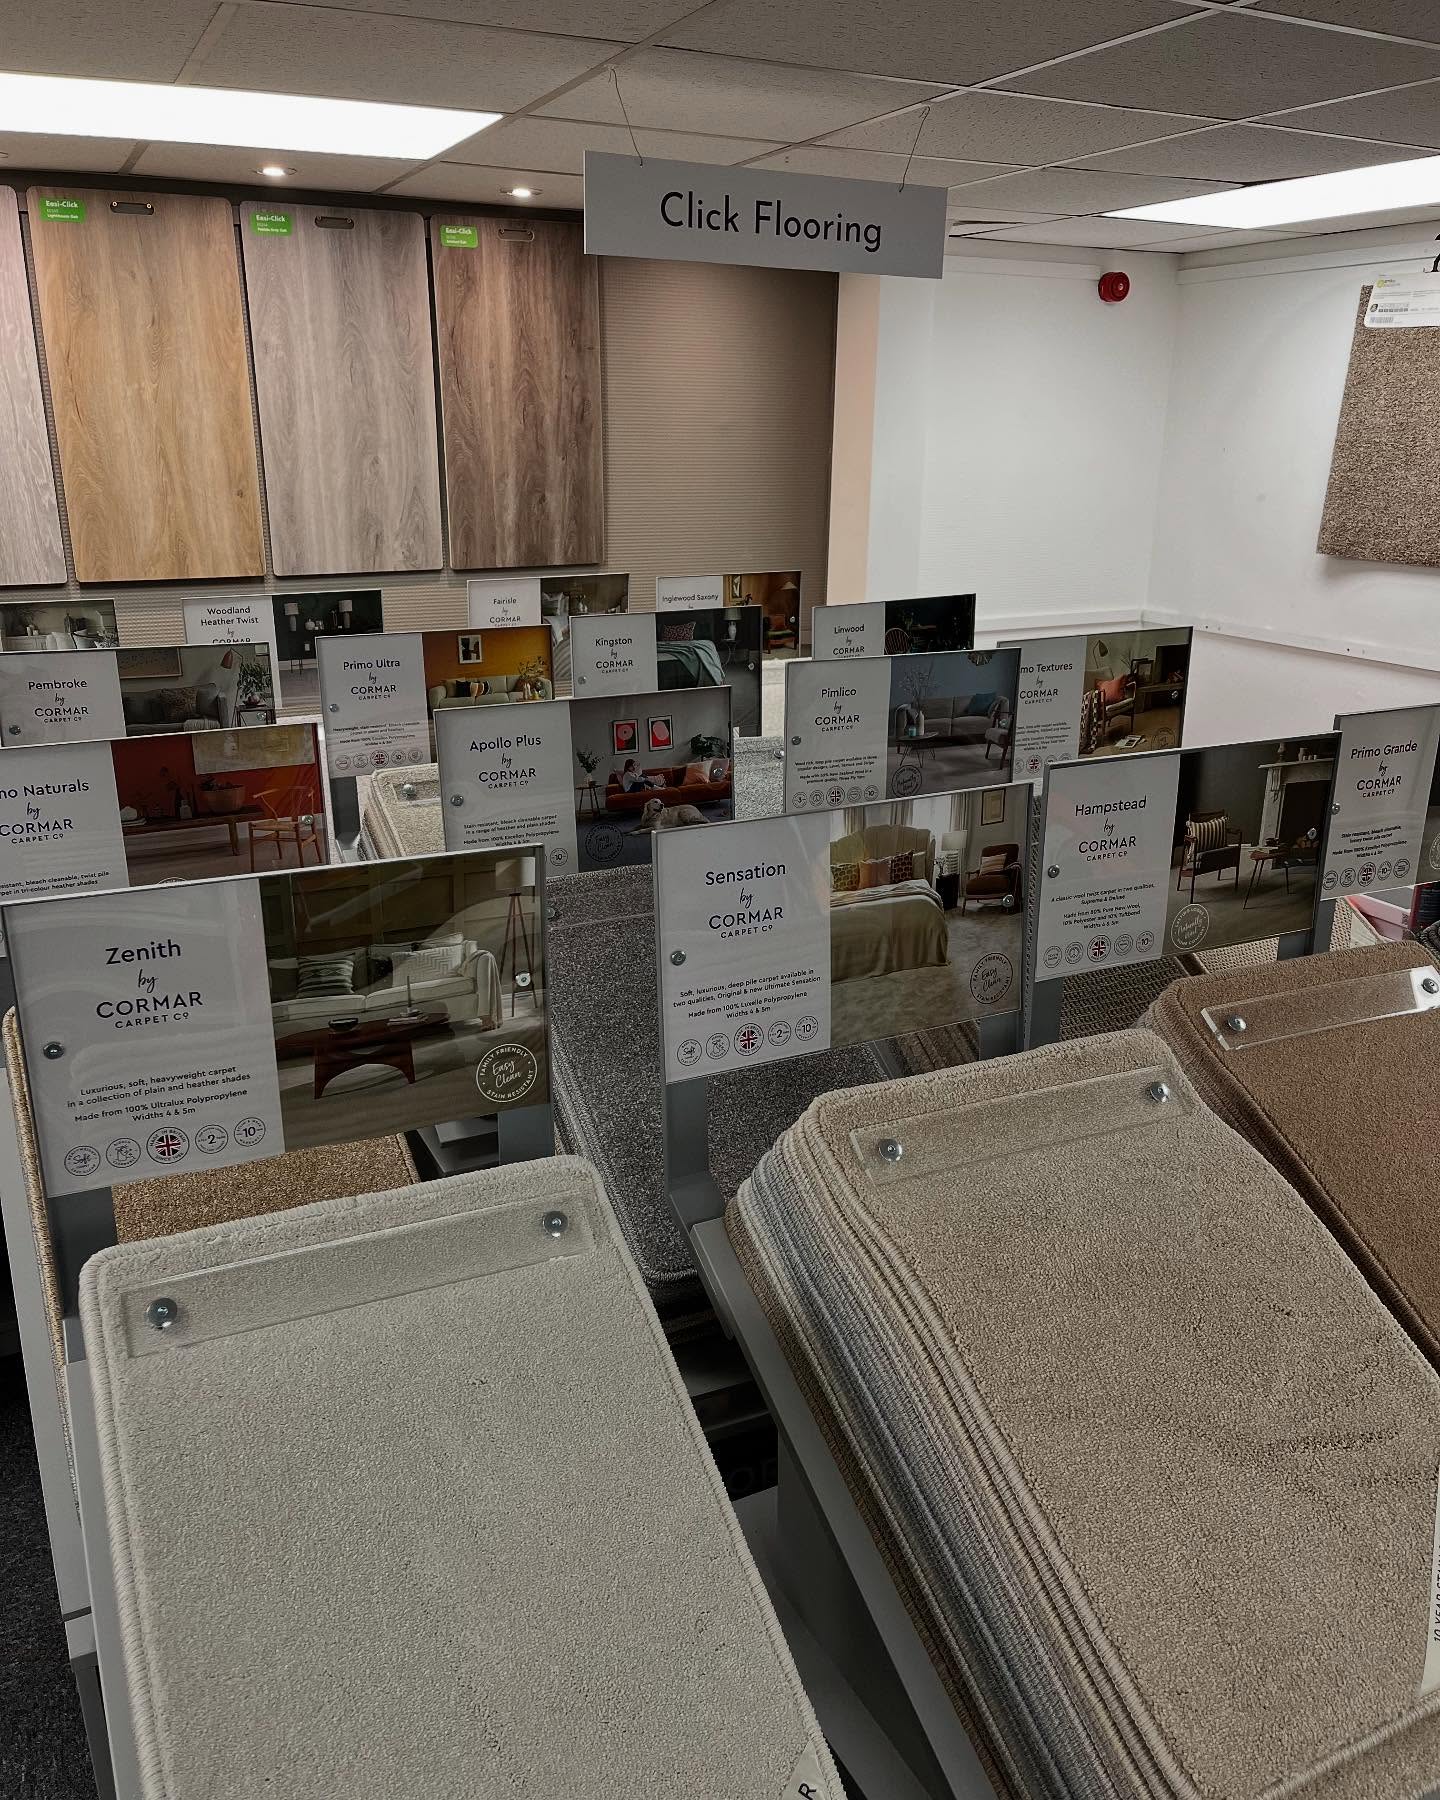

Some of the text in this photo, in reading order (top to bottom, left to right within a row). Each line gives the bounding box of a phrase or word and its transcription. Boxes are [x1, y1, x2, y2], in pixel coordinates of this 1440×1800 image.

[45, 200, 79, 208] Easi-Click
[255, 214, 286, 222] Easi-Click
[660, 190, 882, 253] Click Flooring
[445, 227, 472, 235] Easi-Click
[493, 597, 517, 605] Fairisle
[662, 594, 696, 603] Inglewood
[207, 605, 251, 615] Woodland
[200, 616, 259, 626] Heather Twist
[489, 615, 521, 624] CORMAR
[834, 624, 865, 634] Linwood
[595, 637, 633, 647] Kingston
[832, 646, 865, 656] CORMAR
[343, 658, 401, 671] Primo Ultra
[595, 659, 634, 669] CORMAR
[1036, 662, 1073, 673] Textures
[28, 678, 88, 690] Pembroke
[368, 672, 377, 685] by
[1035, 675, 1044, 688] by
[351, 684, 397, 695] CORMAR
[821, 686, 857, 698] Pimlico
[1019, 688, 1059, 700] CORMAR
[54, 692, 65, 706] by
[34, 706, 89, 717] CORMAR
[833, 701, 842, 714] by
[815, 714, 860, 726] CORMAR
[469, 734, 542, 752] Apollo Plus
[1350, 740, 1418, 759] Primo Grande
[501, 753, 513, 768] by
[478, 767, 537, 782] CORMAR
[1378, 760, 1388, 777] by
[23, 778, 90, 796] Naturals
[488, 781, 517, 789] CARPET
[1356, 775, 1402, 791] CORMAR
[1362, 790, 1387, 798] CARPET
[26, 801, 41, 820] by
[1075, 794, 1147, 816] Hampstead
[0, 818, 74, 837] CORMAR
[1103, 817, 1115, 837] by
[11, 834, 49, 844] CARPET
[1078, 836, 1137, 854] CORMAR
[1086, 852, 1117, 862] CARPET
[25, 878, 47, 887] bleach
[47, 874, 80, 883] cleanable,
[97, 870, 110, 878] pile
[705, 862, 786, 886] Sensation
[76, 879, 99, 887] shades
[739, 887, 754, 909] by
[708, 906, 784, 930] CORMAR
[720, 926, 759, 939] CARPET
[1140, 937, 1149, 946] 10
[105, 939, 182, 965] Zenith
[985, 955, 1007, 965] FRIENDLY
[137, 968, 158, 993] by
[981, 967, 998, 981] Easy
[680, 989, 695, 998] Soft,
[696, 985, 727, 995] luxurious,
[727, 981, 745, 989] deep
[745, 978, 757, 987] pile
[758, 975, 779, 983] carpet
[780, 970, 807, 980] available
[687, 995, 716, 1005] qualities,
[717, 989, 742, 999] Original
[749, 986, 763, 994] new
[764, 981, 791, 991] Ultimate
[791, 976, 821, 986] Sensation
[982, 977, 1001, 992] Clean
[96, 991, 204, 1019] CORMAR
[688, 1010, 705, 1018] Made
[723, 1003, 740, 1012] 100%
[740, 999, 763, 1008] Luxelle
[763, 991, 808, 1004] Polypropylene
[726, 1010, 748, 1019] Widths
[115, 1014, 168, 1029] CARPET
[776, 1029, 783, 1038] 2
[802, 1024, 812, 1033] 10
[480, 1046, 528, 1076] FAMILY FRIENDLY
[492, 1060, 515, 1076] Easy
[80, 1066, 237, 1096] Luxurious, soft, heavyweight carpet
[486, 1070, 534, 1099] STAIN RESISTANT
[495, 1071, 521, 1088] Clean
[67, 1100, 76, 1108] in
[86, 1092, 131, 1105] collection
[133, 1089, 142, 1097] of
[144, 1085, 165, 1096] plain
[167, 1083, 184, 1092] and
[186, 1079, 219, 1089] heather
[221, 1073, 251, 1084] shades
[74, 1089, 248, 1122] Made from 100% Ultralux Polypropylene
[131, 1111, 163, 1121] Widths
[166, 1109, 172, 1117] 4
[182, 1107, 196, 1115] 5m
[242, 1126, 256, 1138] 10
[207, 1134, 216, 1144] 2
[797, 1783, 817, 1800] R
